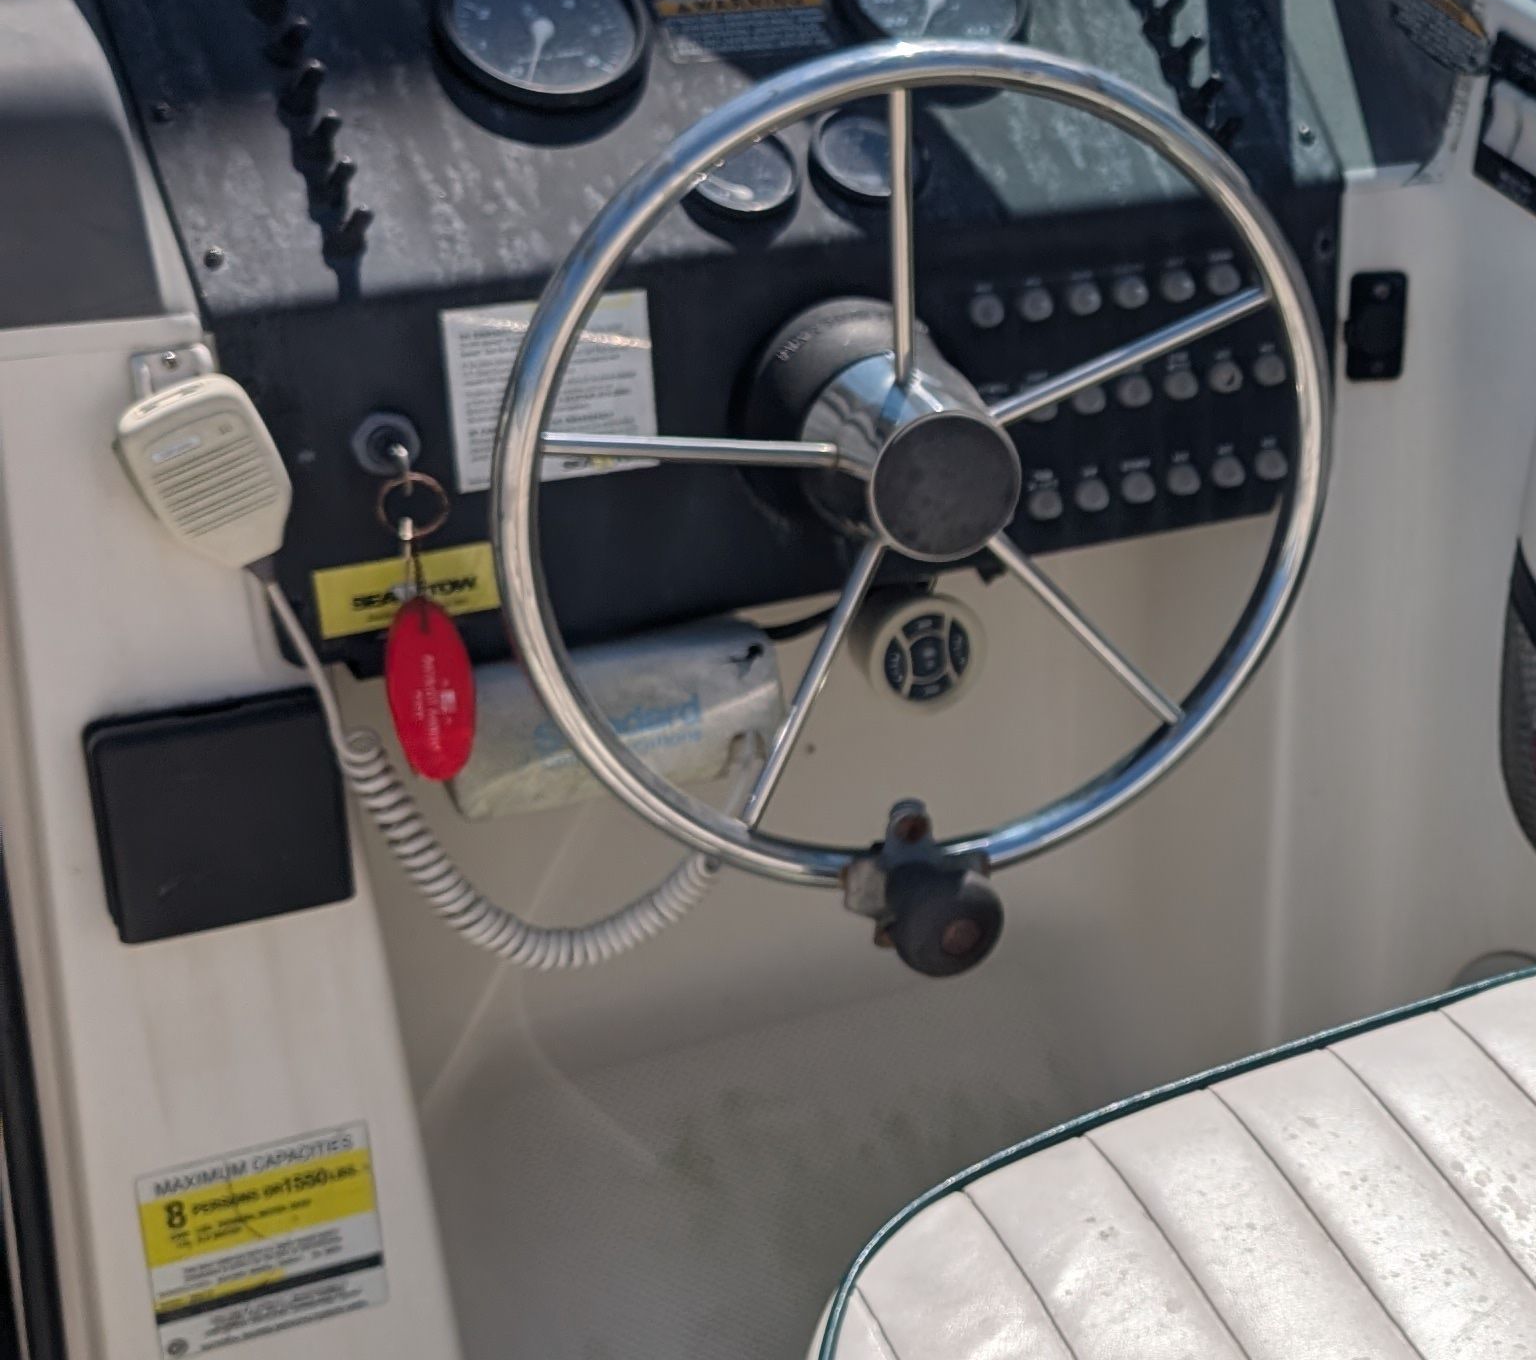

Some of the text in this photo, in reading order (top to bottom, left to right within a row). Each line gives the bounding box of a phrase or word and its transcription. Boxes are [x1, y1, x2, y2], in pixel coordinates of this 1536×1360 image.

[154, 1133, 354, 1196] MAXIMUM CAPACITIES
[165, 1200, 188, 1229] 8
